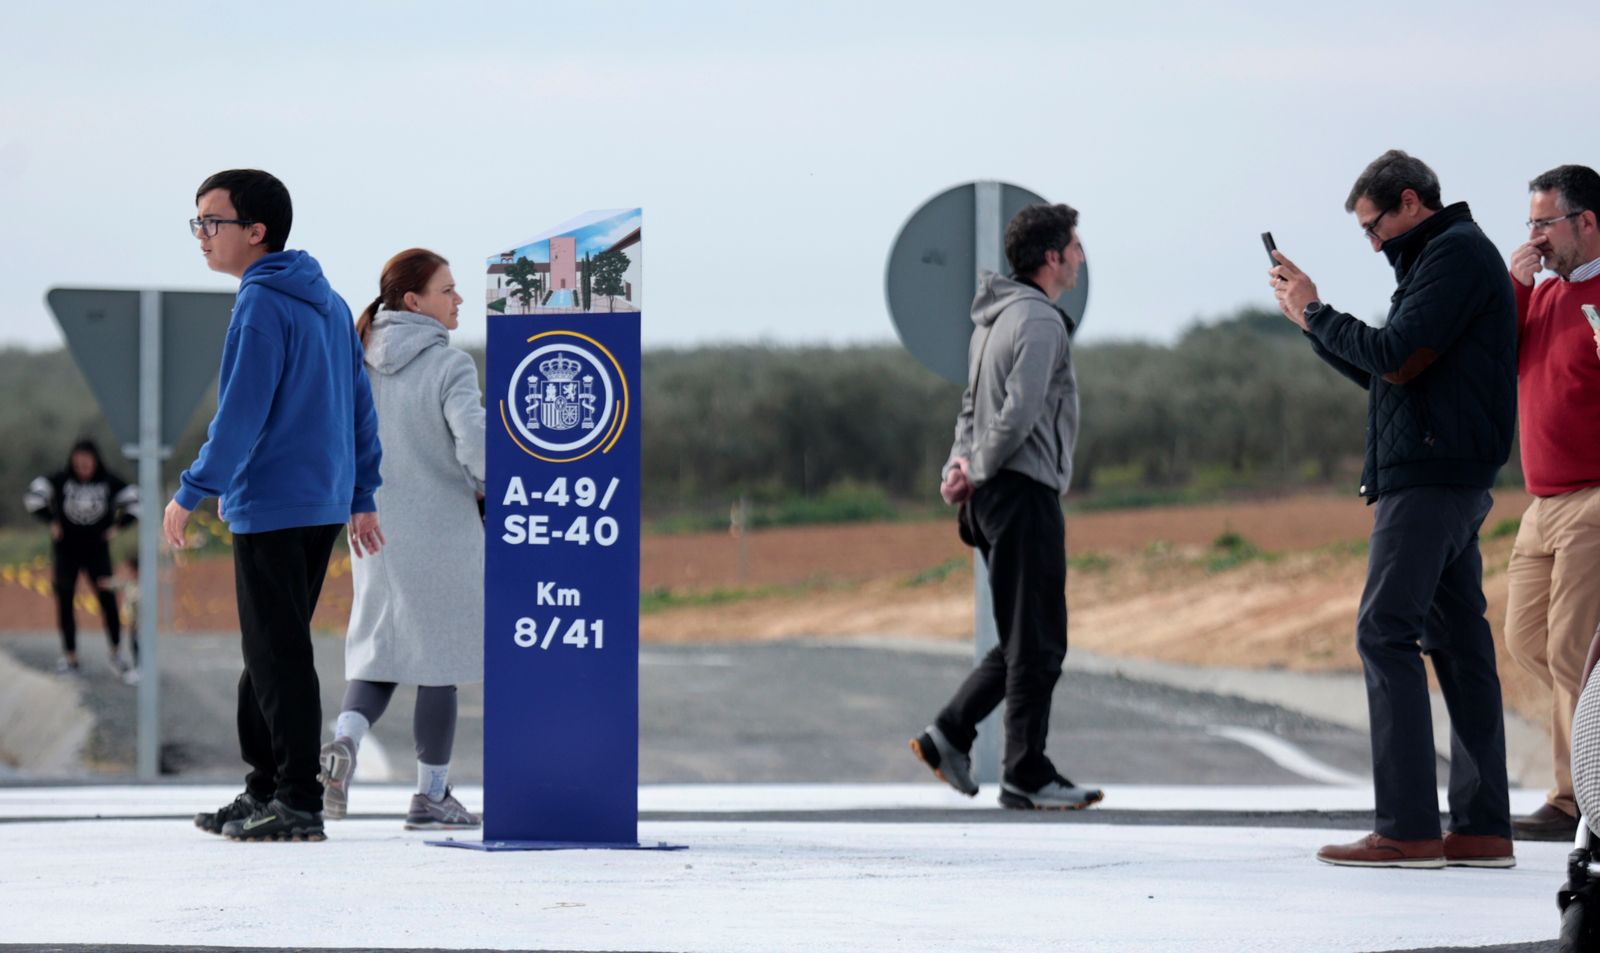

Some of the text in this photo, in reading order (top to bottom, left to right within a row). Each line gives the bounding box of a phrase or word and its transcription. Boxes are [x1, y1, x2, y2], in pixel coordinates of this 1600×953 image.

[502, 476, 620, 511] A-49/
[502, 514, 619, 546] SE-40
[536, 581, 580, 606] Km
[514, 616, 603, 650] 8/41
